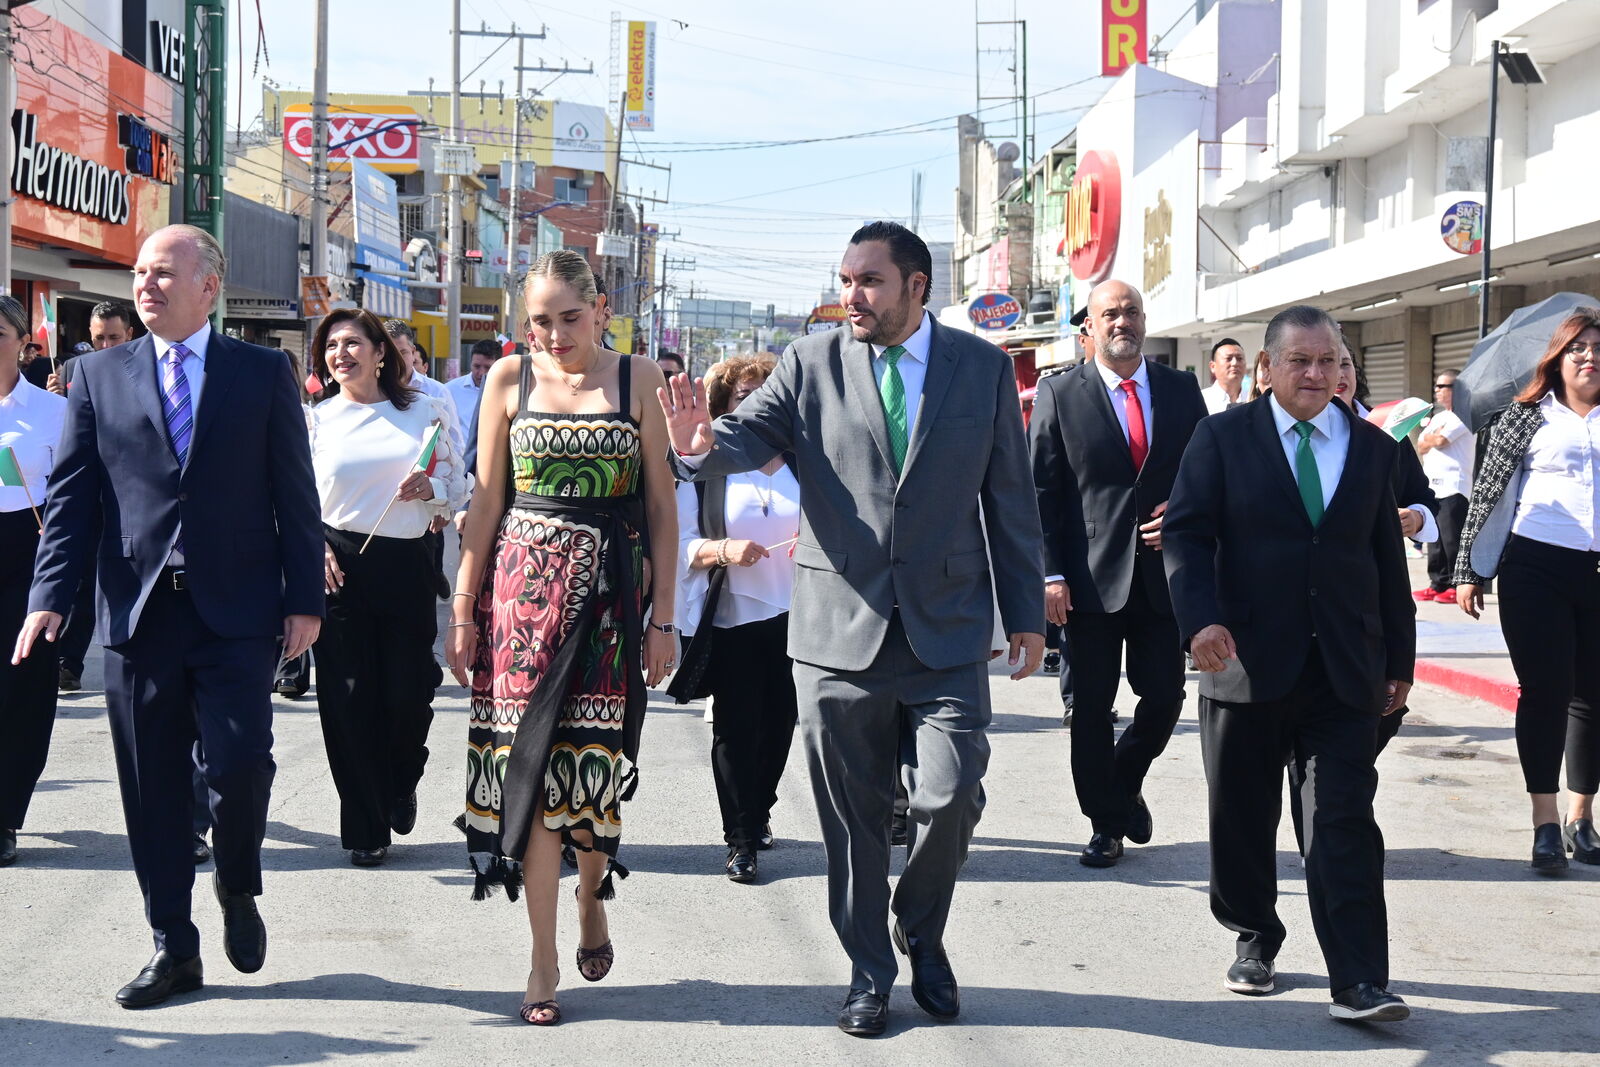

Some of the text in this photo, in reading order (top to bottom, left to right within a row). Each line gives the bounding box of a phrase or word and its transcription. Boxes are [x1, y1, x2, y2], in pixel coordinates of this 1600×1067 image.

[629, 30, 645, 85] elektra
[288, 116, 412, 157] OXXO
[15, 109, 132, 226] Hermanos
[151, 130, 177, 186] Vale
[460, 304, 499, 314] PATERIA
[969, 301, 1020, 323] VIAJEROS
[988, 320, 1003, 328] BAR
